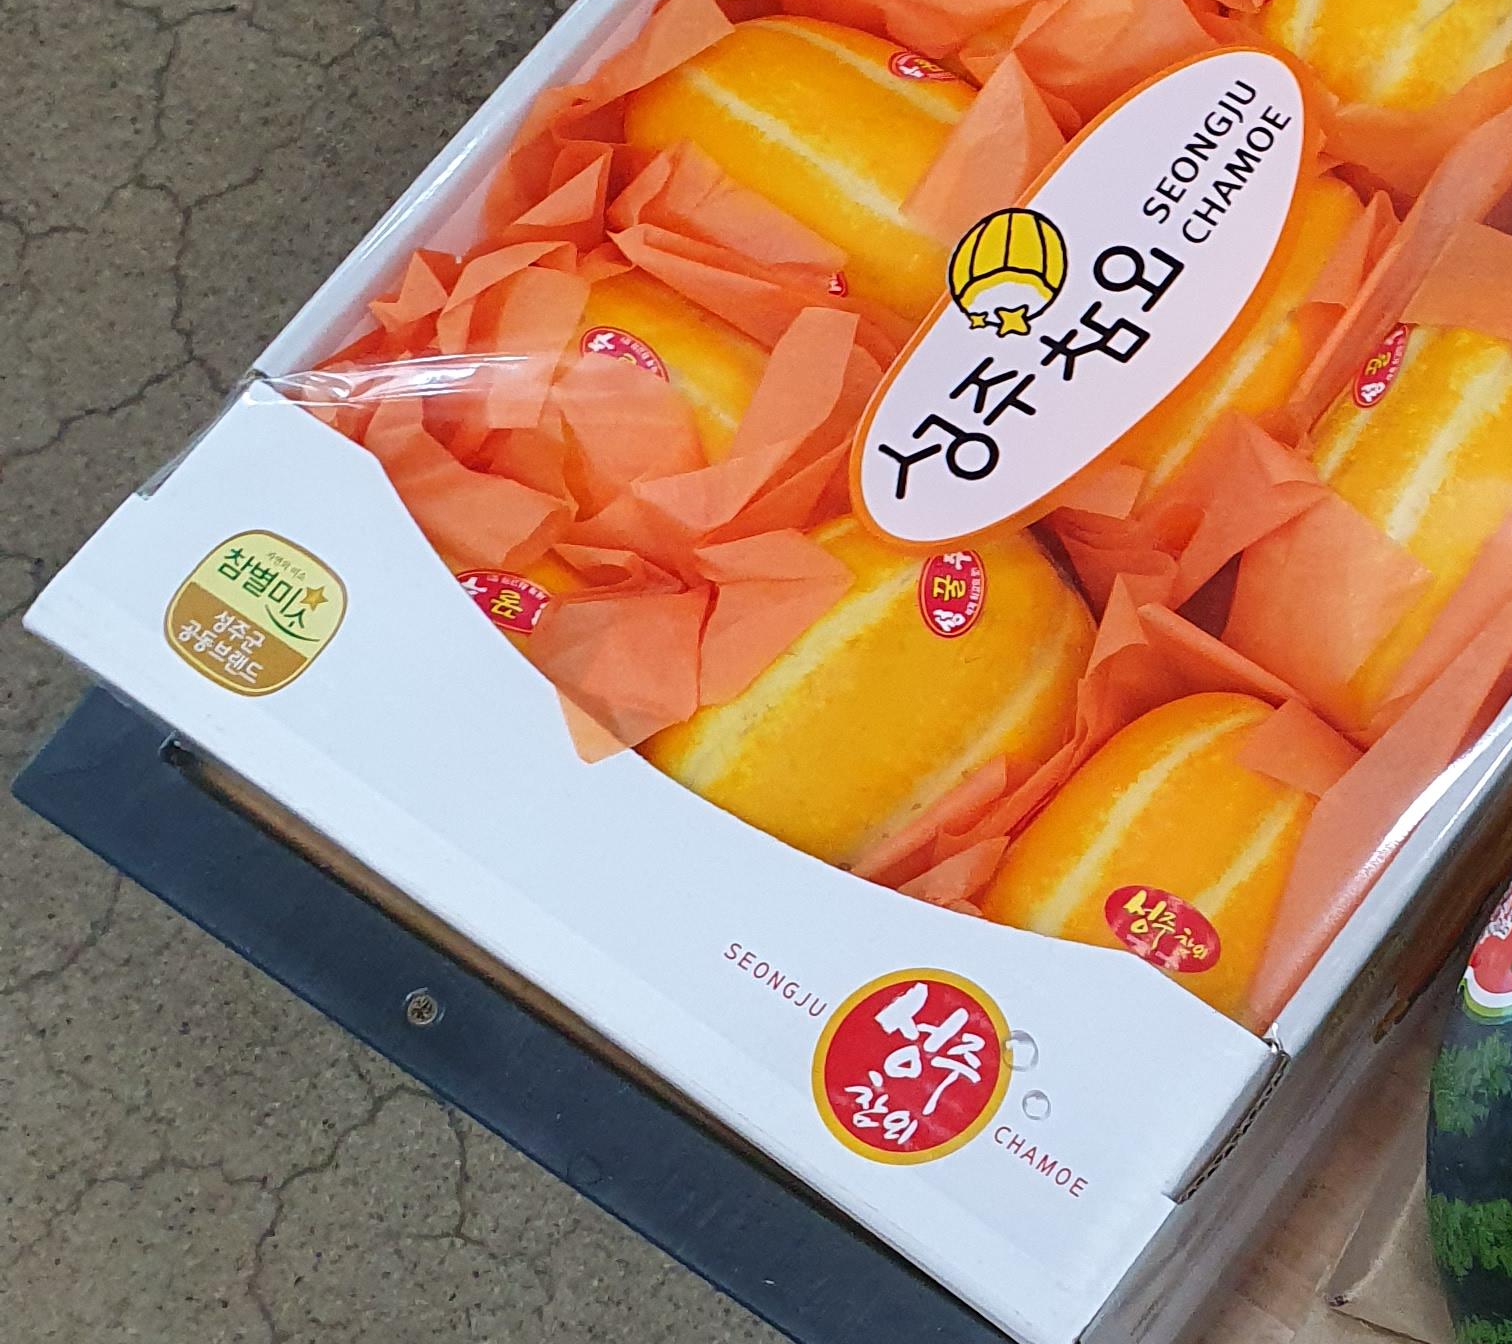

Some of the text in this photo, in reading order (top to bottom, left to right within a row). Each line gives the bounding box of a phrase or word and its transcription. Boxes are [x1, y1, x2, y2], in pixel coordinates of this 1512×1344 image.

[1143, 79, 1257, 225] SEONGJU
[1183, 105, 1291, 245] CHAMOE
[879, 245, 1184, 499] 성주참외
[177, 618, 264, 684] 공동브랜드
[214, 609, 266, 654] 성주군
[723, 942, 829, 1018] SEONGJU
[993, 1125, 1090, 1198] CHAMOE
